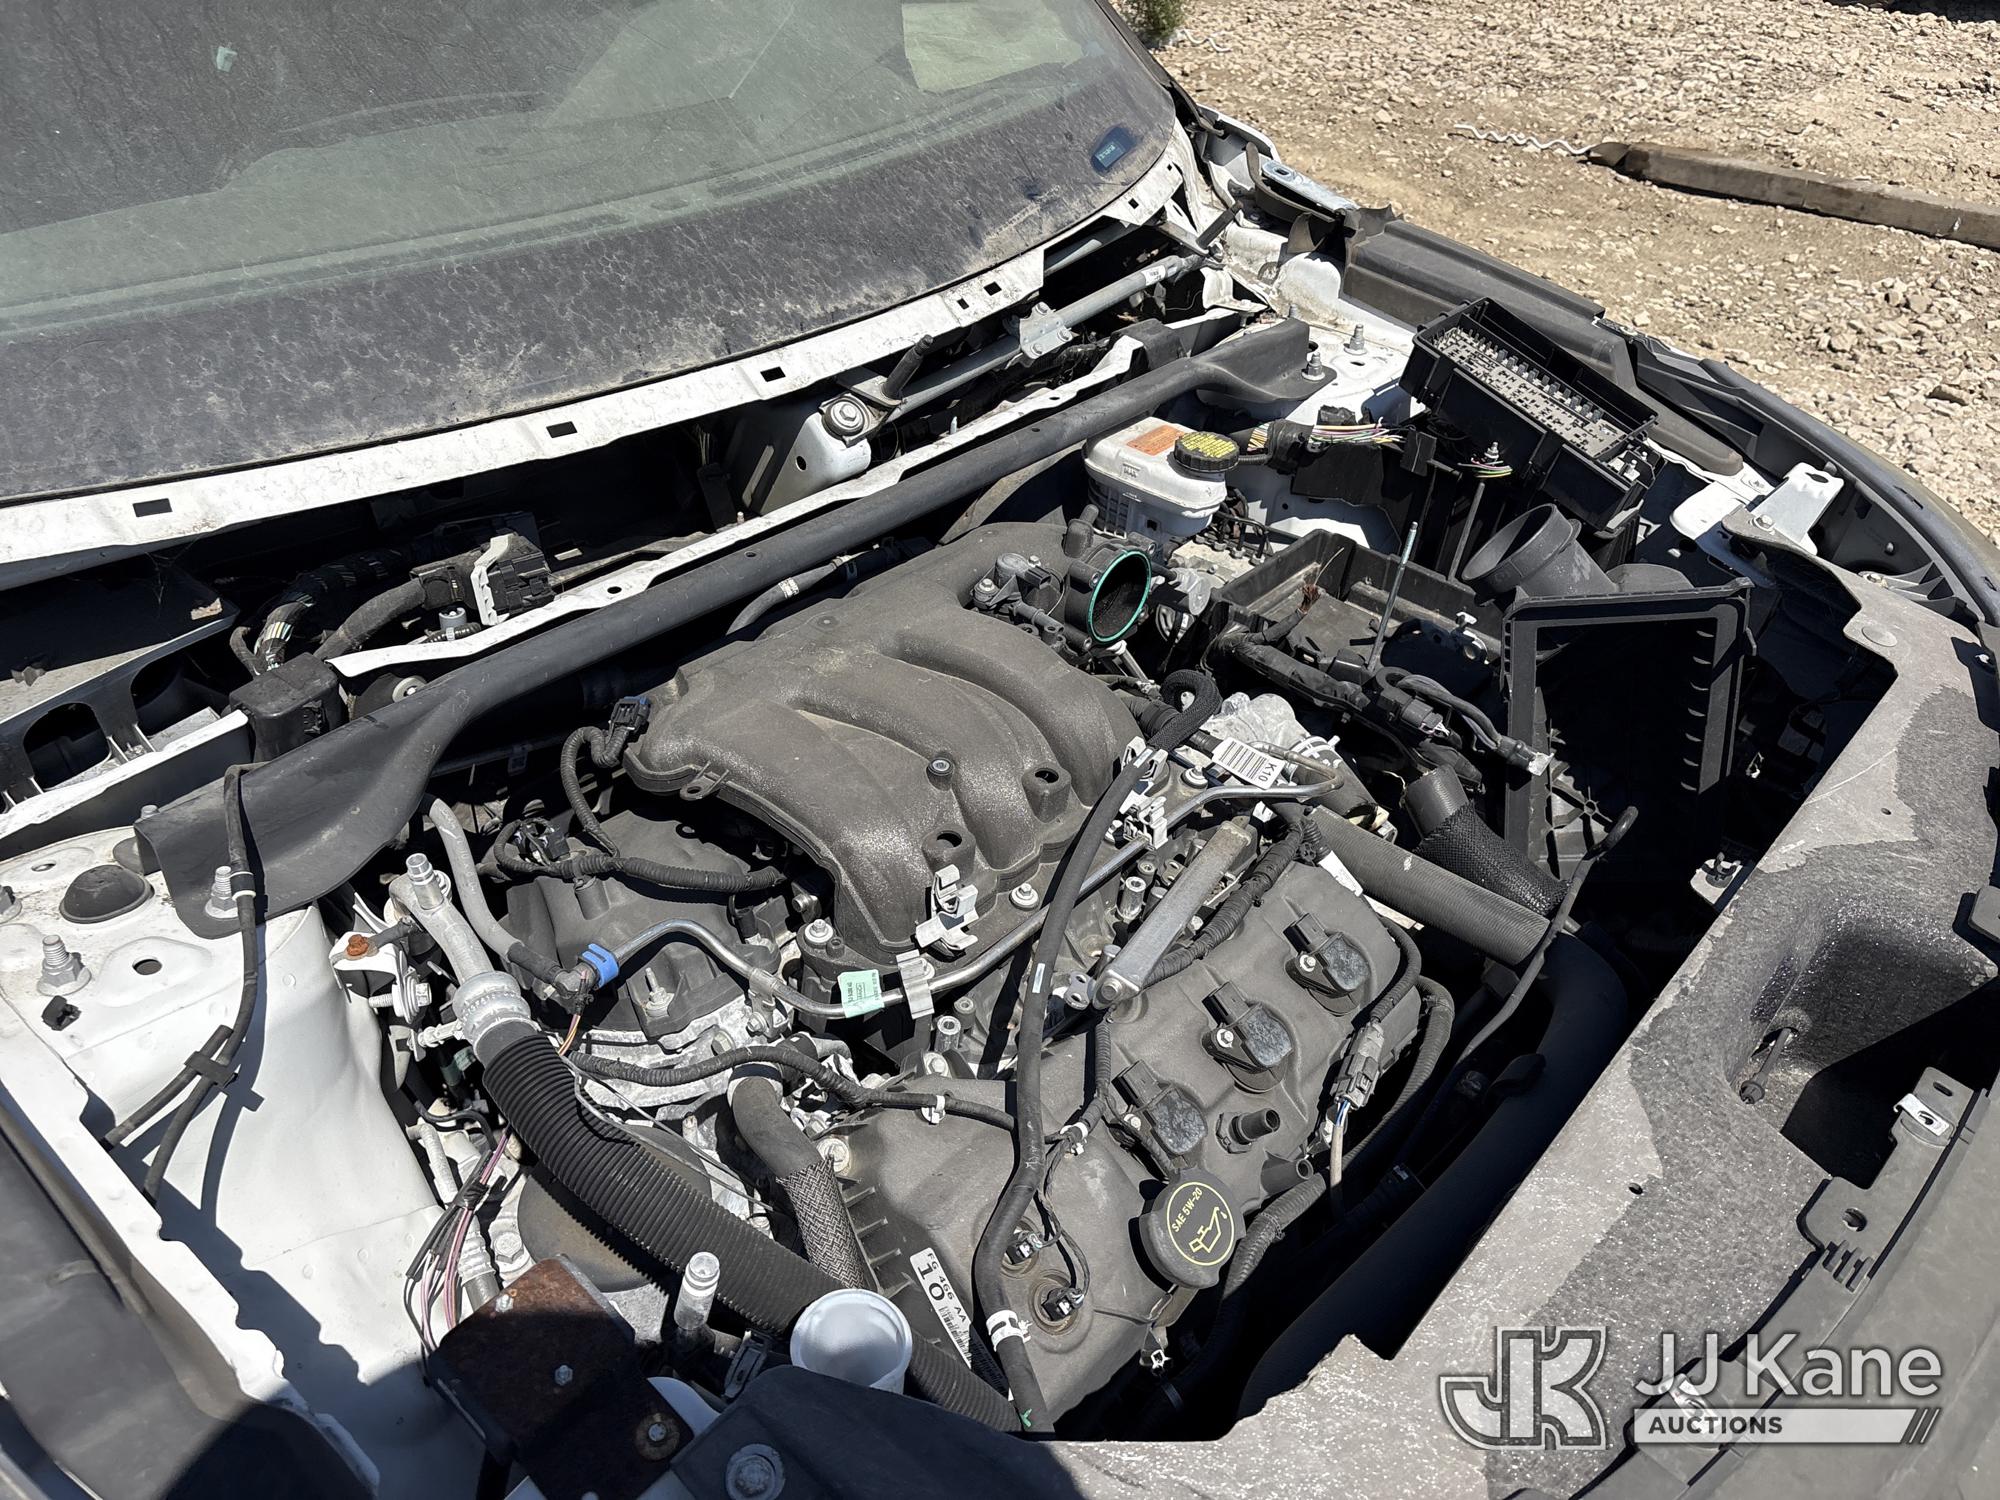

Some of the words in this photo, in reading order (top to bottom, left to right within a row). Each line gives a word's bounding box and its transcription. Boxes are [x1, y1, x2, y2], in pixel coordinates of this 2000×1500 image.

[1258, 762, 1278, 782] K10
[1171, 1214, 1187, 1233] SAE
[1183, 1187, 1204, 1216] 5W-20
[917, 1262, 946, 1301] 10
[928, 1252, 939, 1270] FG
[939, 1275, 955, 1300] 466
[954, 1306, 968, 1323] AA
